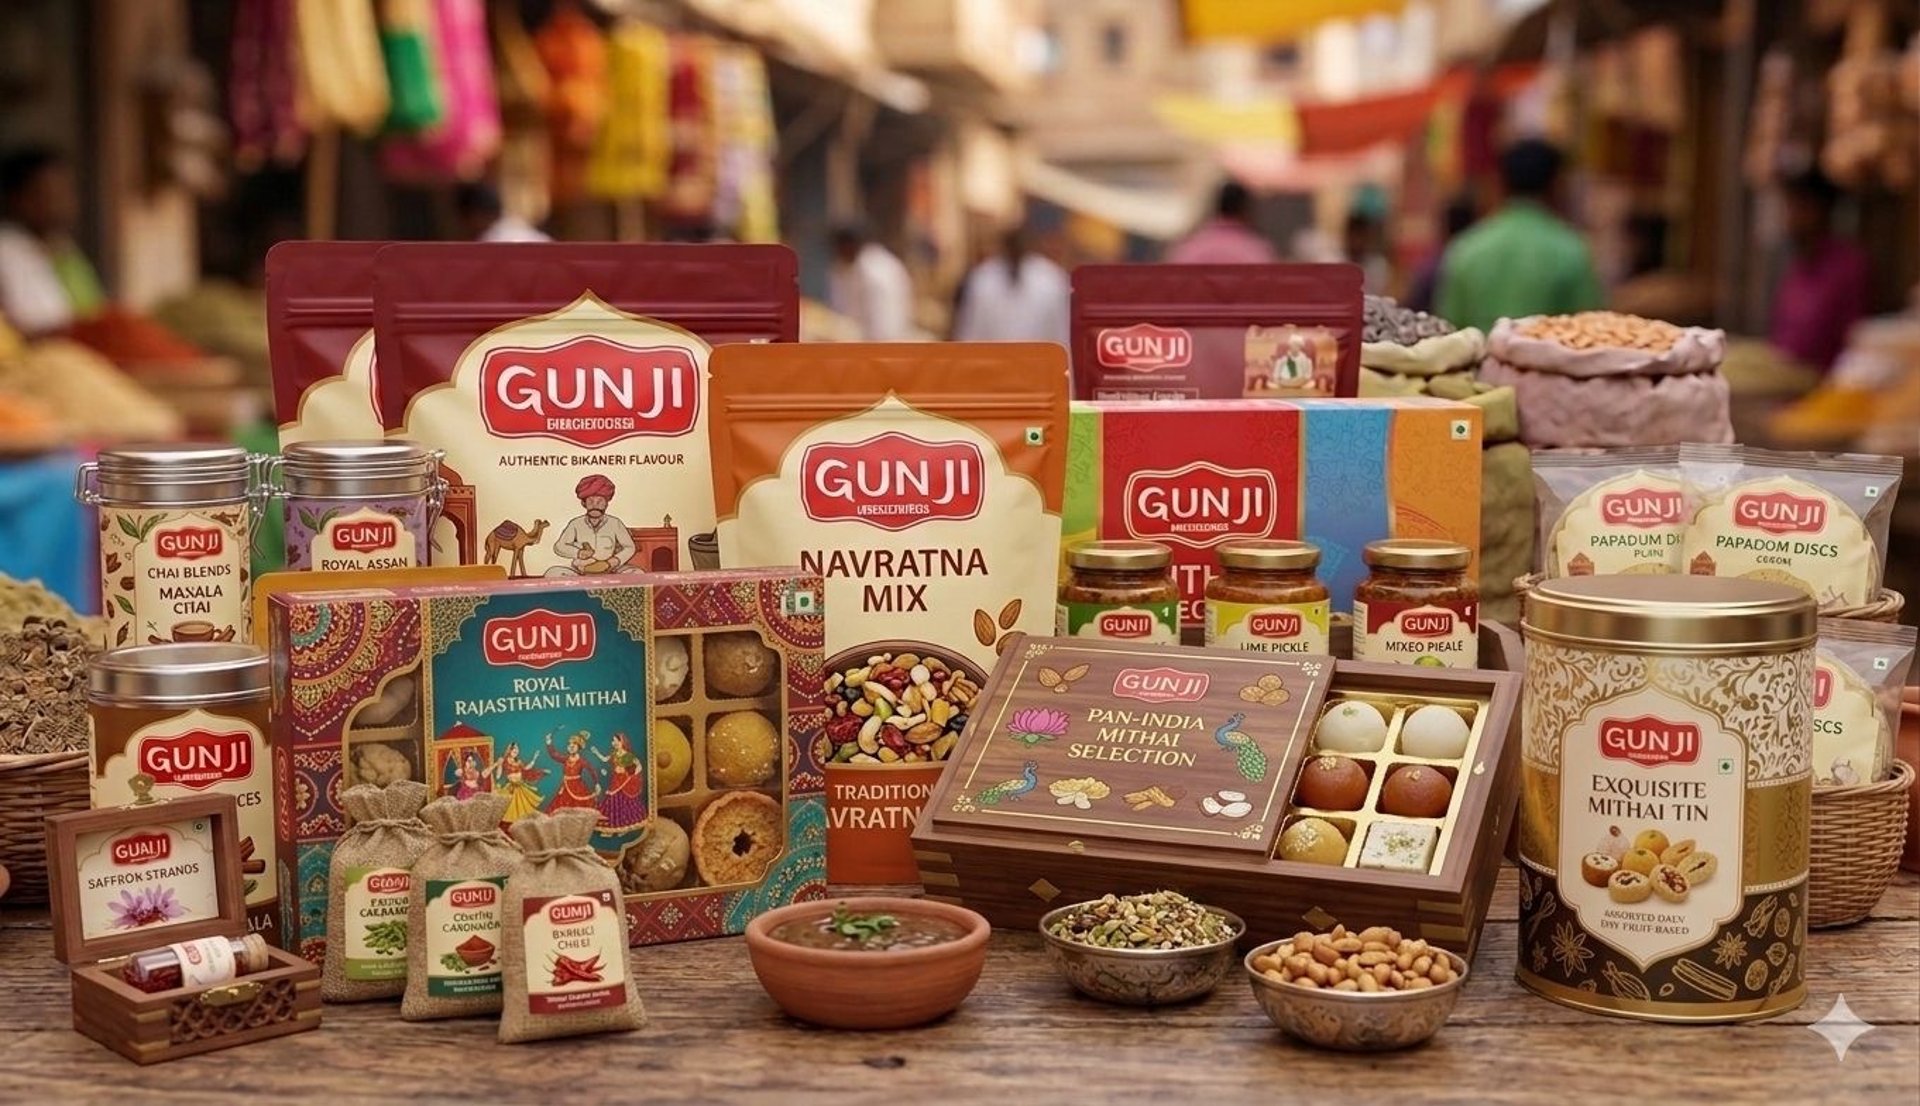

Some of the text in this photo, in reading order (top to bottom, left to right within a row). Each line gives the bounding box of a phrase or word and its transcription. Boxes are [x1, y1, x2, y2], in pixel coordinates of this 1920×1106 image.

[497, 365, 682, 418] GUNJI
[499, 454, 684, 466] AUTHENTIC BIKANERI FLAVOUR
[815, 459, 969, 504] GUNJI
[1138, 487, 1263, 525] GUNJI
[1740, 500, 1820, 525] GUNJI
[337, 527, 392, 545] GUNJI
[1591, 534, 1661, 547] PAPADUM
[1716, 535, 1838, 558] PAPADOM DISCS
[147, 564, 231, 579] CHAI BLENDS
[322, 559, 363, 571] ROYAL
[800, 548, 988, 577] NAVRATNA
[863, 584, 928, 612] MIX
[492, 623, 588, 653] GUNJI
[1271, 642, 1309, 653] PICKLE
[513, 676, 570, 693] ROYAL
[1122, 674, 1201, 695] GUNJI
[455, 690, 627, 716] RAJASTHANI MITHAI
[1087, 708, 1205, 730] PAN-INDIA
[1096, 728, 1180, 747] MITHAI
[1606, 727, 1693, 756] GUNJI
[146, 741, 247, 773] GUNJI
[1067, 744, 1197, 767] SELECTION
[1592, 774, 1707, 799] EXQUISITE
[1589, 797, 1708, 821] MITHAI TIN
